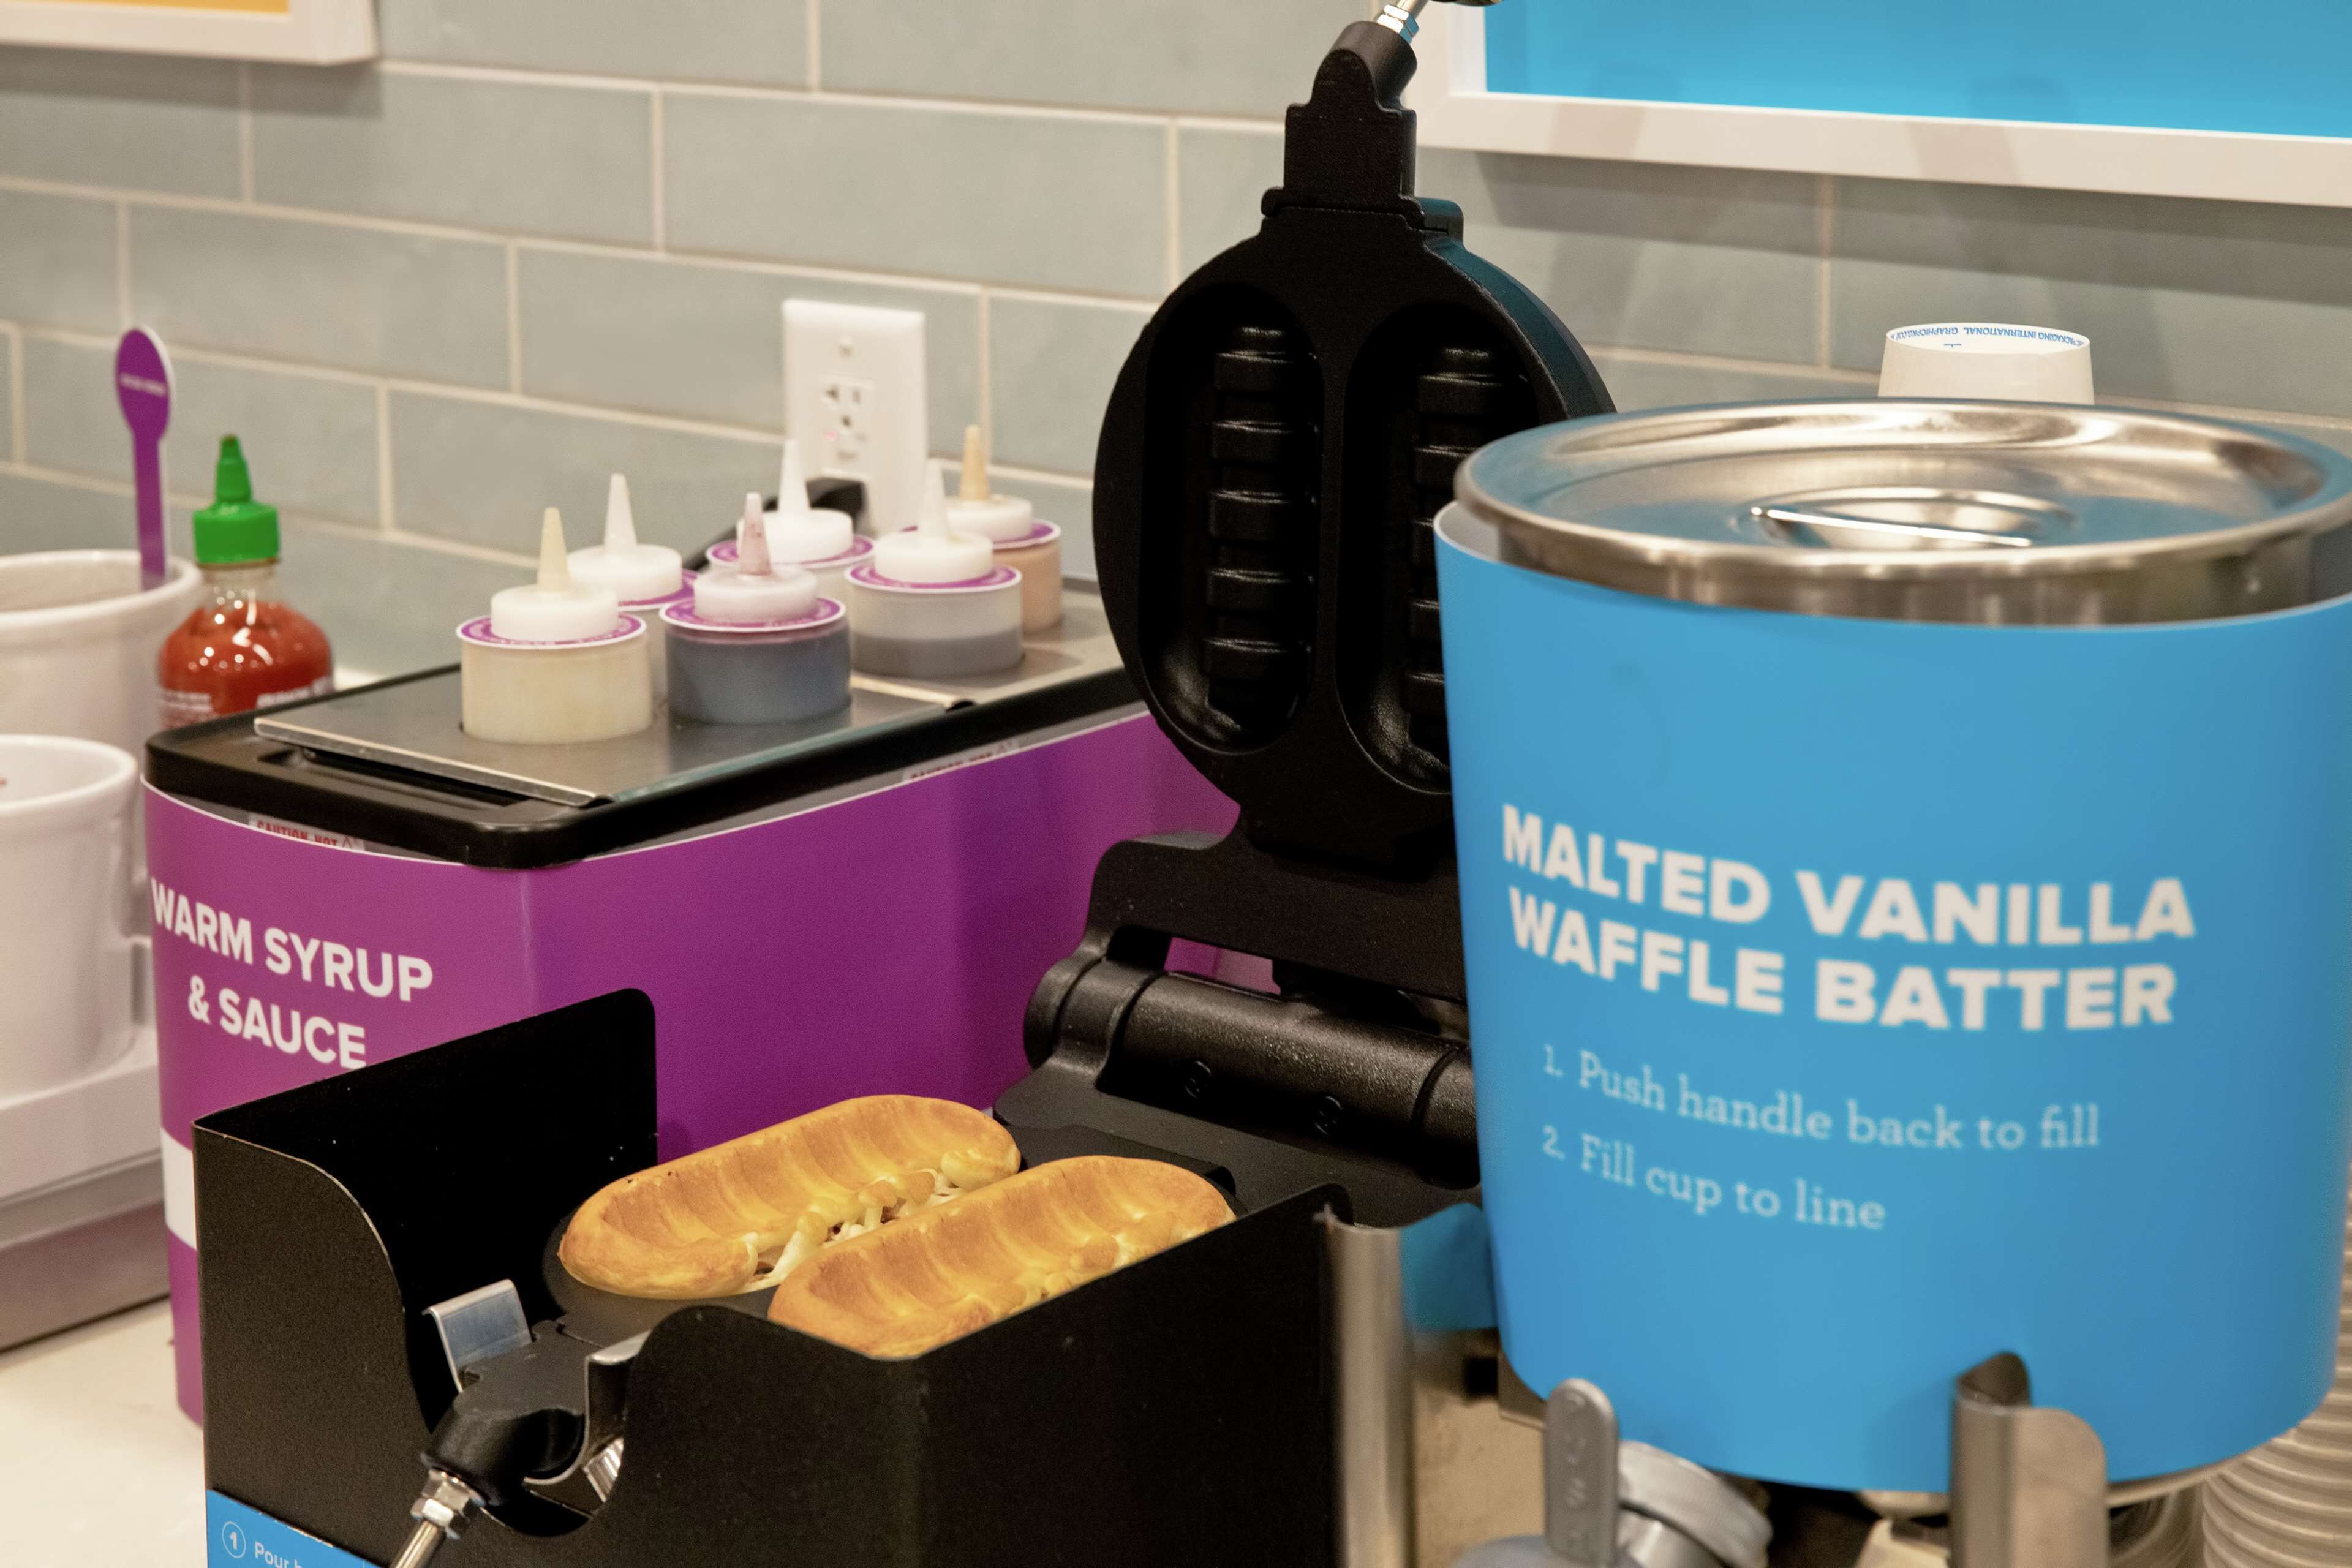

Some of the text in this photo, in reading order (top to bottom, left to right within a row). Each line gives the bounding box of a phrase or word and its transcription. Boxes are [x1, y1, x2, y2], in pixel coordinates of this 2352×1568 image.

[1963, 327, 2037, 339] INTERNATIONAL
[1503, 804, 2195, 946] MALTED VANILLA
[151, 877, 434, 1002] WARM SYRUP
[1509, 886, 2177, 1031] WAFFLE BATTER
[187, 975, 368, 1070] & SAUCE
[1544, 1044, 2100, 1149] 1. Push handle back to fill
[1543, 1125, 1887, 1230] 2. Fill cup to line
[228, 1531, 290, 1568] 1 Pour
